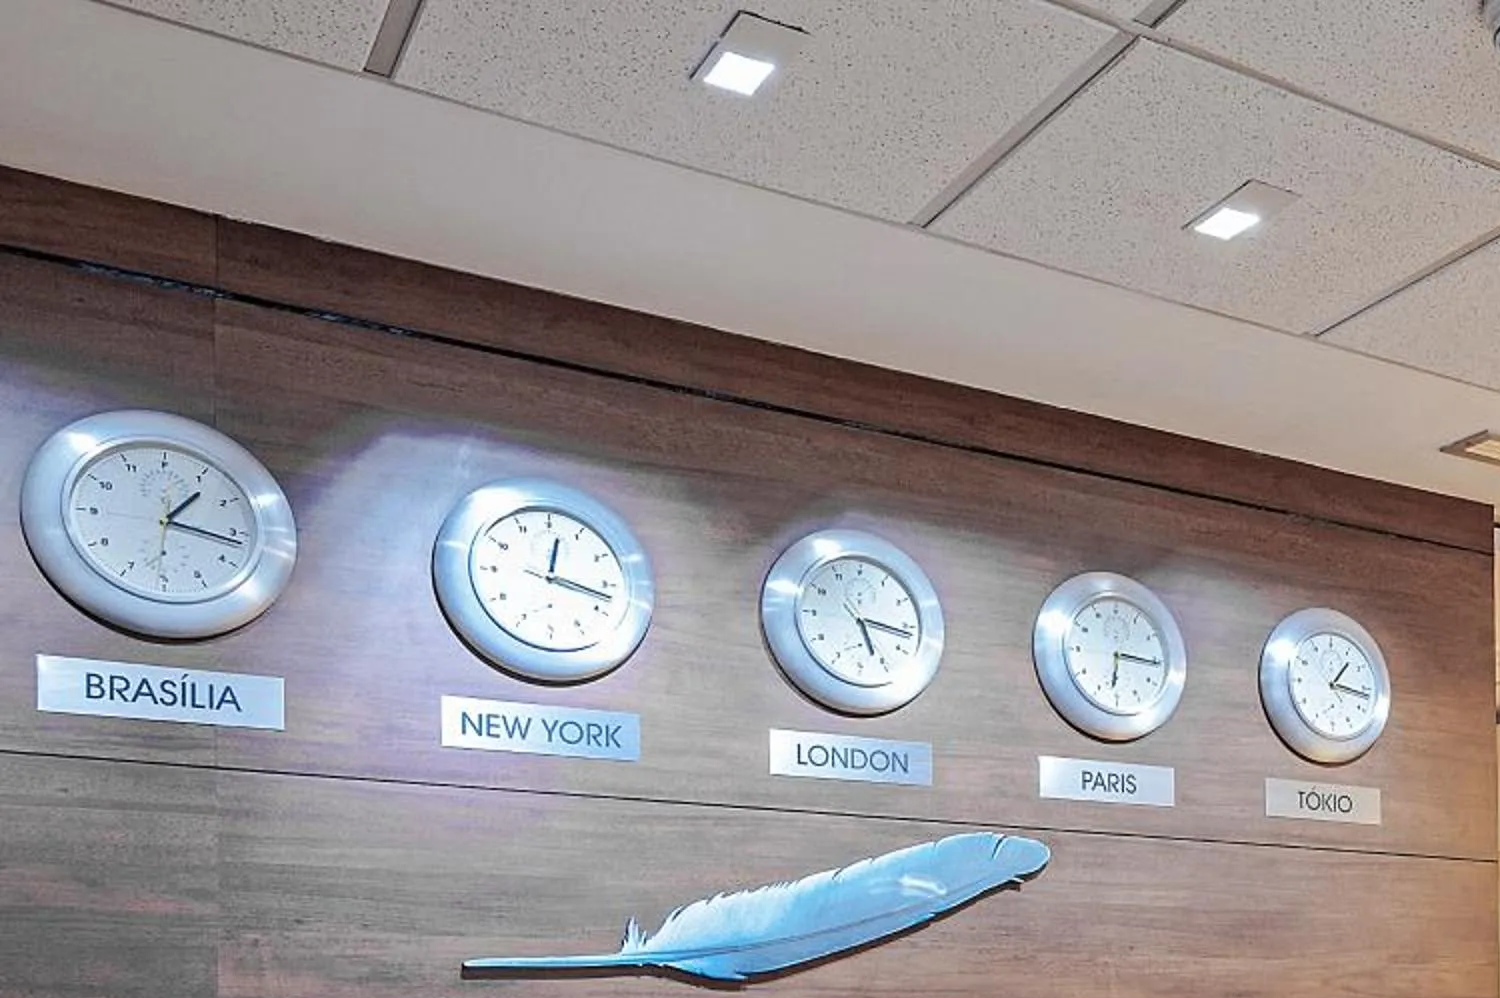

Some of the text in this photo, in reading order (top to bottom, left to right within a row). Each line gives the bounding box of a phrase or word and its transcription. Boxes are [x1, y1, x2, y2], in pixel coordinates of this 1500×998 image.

[84, 672, 243, 713] BRASÍLIA
[460, 711, 623, 749] NEW YORK
[796, 742, 909, 775] LONDON
[1080, 770, 1138, 795] PARIS
[1297, 789, 1354, 814] TÓKIO
